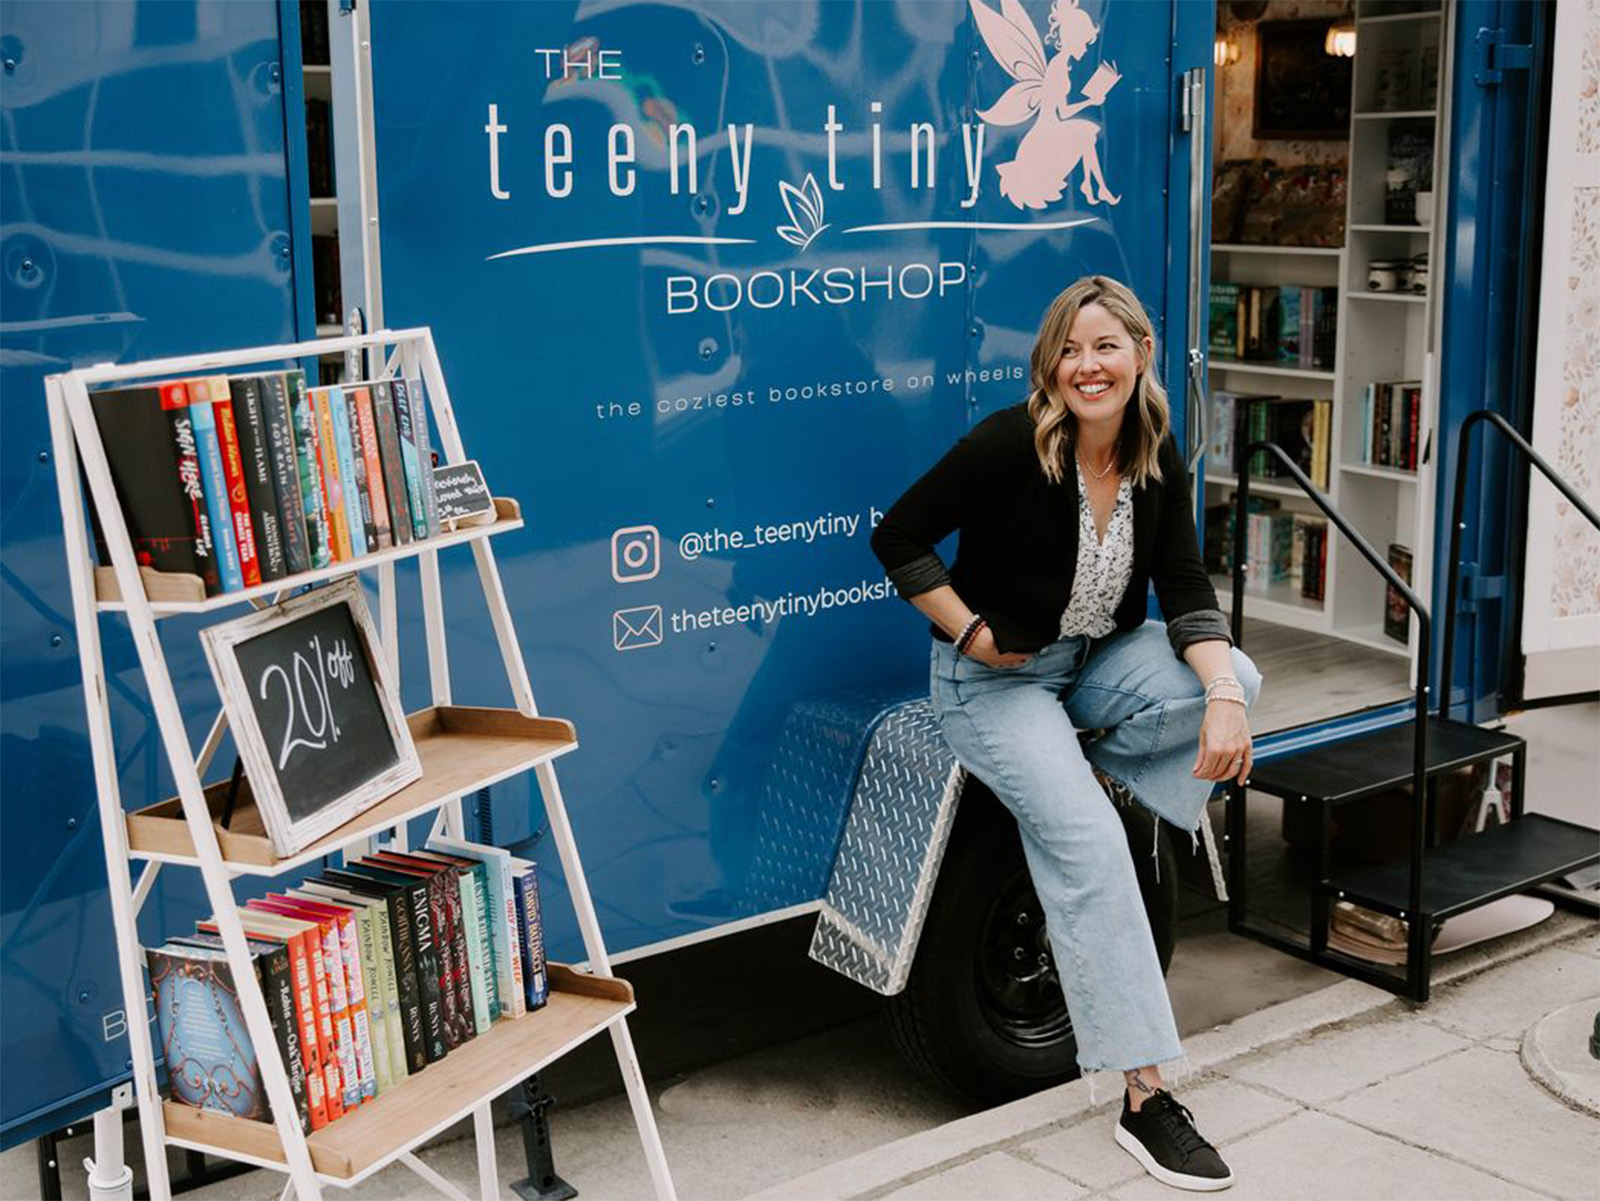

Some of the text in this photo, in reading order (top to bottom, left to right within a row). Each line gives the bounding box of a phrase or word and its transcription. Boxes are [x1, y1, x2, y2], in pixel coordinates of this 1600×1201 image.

[534, 48, 622, 79] THE
[485, 102, 984, 215] teeny tiny
[667, 262, 966, 314] BOOKSHOP
[394, 383, 408, 413] DEEP
[597, 366, 1023, 419] the coziest bookstore on wheels
[274, 382, 296, 471] FIFTY WORDS
[174, 417, 203, 501] SIGN HERE
[270, 422, 288, 484] FOR RAIN
[234, 511, 249, 562] CHANCE YEAR
[679, 512, 860, 560] @the_teenytiny
[260, 635, 354, 770] 20% off
[412, 887, 433, 952] ENIGMA
[524, 889, 537, 922] DAVID
[311, 950, 326, 980] OTHER
[360, 918, 382, 1000] RAINBOW ROWELL
[377, 910, 399, 991] RAINBOW ROWELL
[505, 898, 515, 924] ONLY
[511, 956, 521, 984] WEEK
[528, 922, 542, 972] BALDACCI
[294, 957, 309, 988] OTHER
[315, 981, 328, 1002] SIDE
[299, 988, 312, 1011] SIDE
[302, 1010, 314, 1023] OF
[319, 1002, 330, 1014] OF
[408, 1006, 421, 1042] RUNYX
[428, 1001, 440, 1037] RUNYX
[278, 986, 305, 1094] Robin Oak Throne
[303, 1023, 317, 1046] NOW
[320, 1016, 333, 1037] NOW
